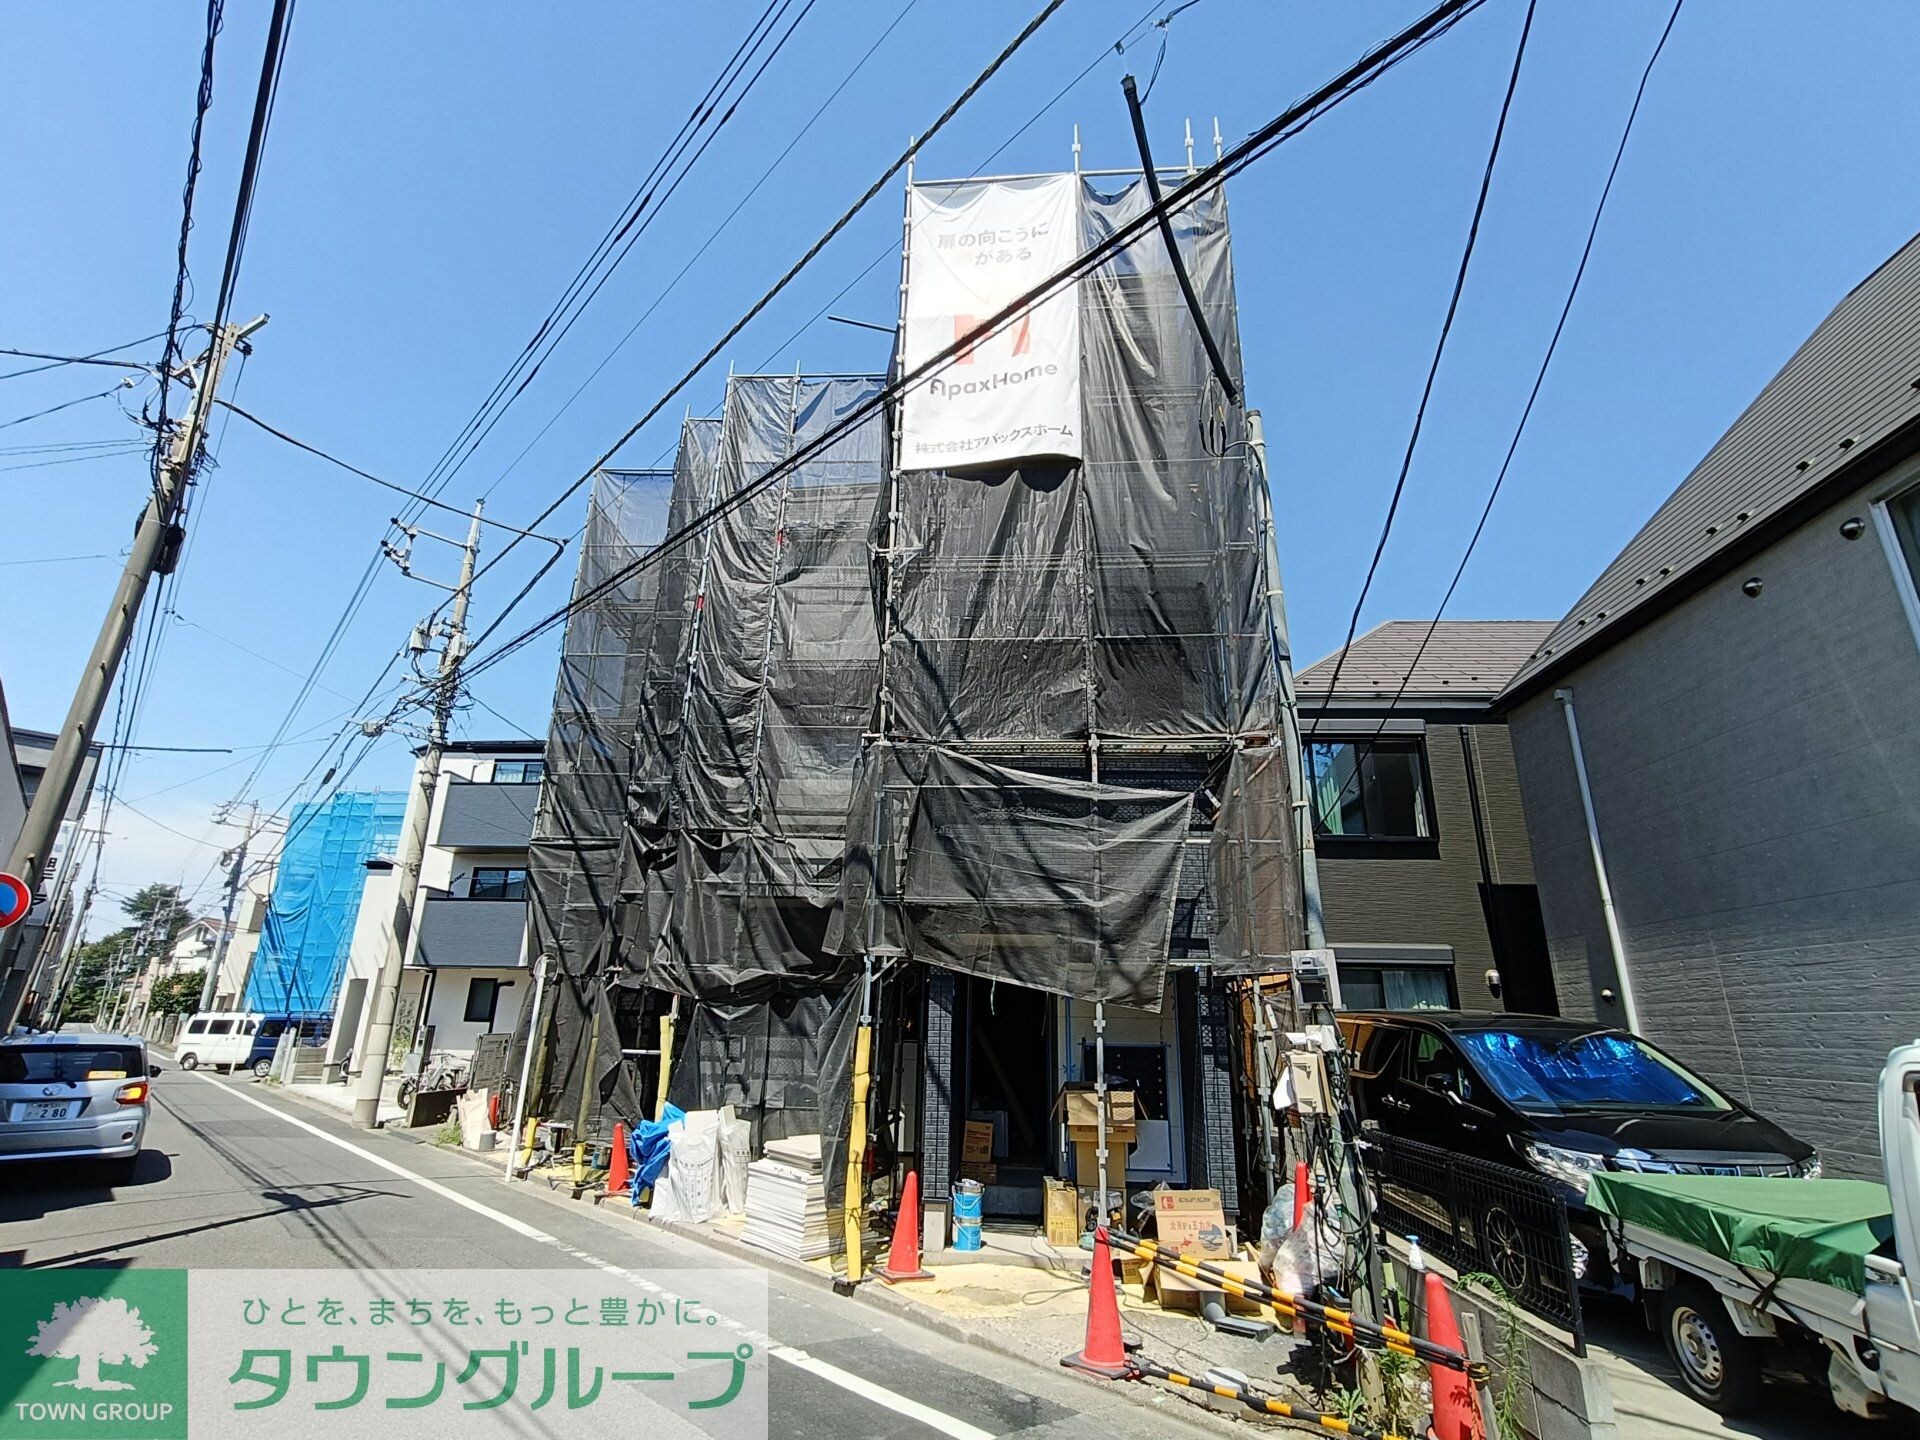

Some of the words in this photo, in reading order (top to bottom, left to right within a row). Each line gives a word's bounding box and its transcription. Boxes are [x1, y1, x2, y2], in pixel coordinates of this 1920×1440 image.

[937, 222, 1048, 249] 扉の向こうに
[975, 246, 1032, 266] がある
[929, 363, 1059, 400] ApaxHome
